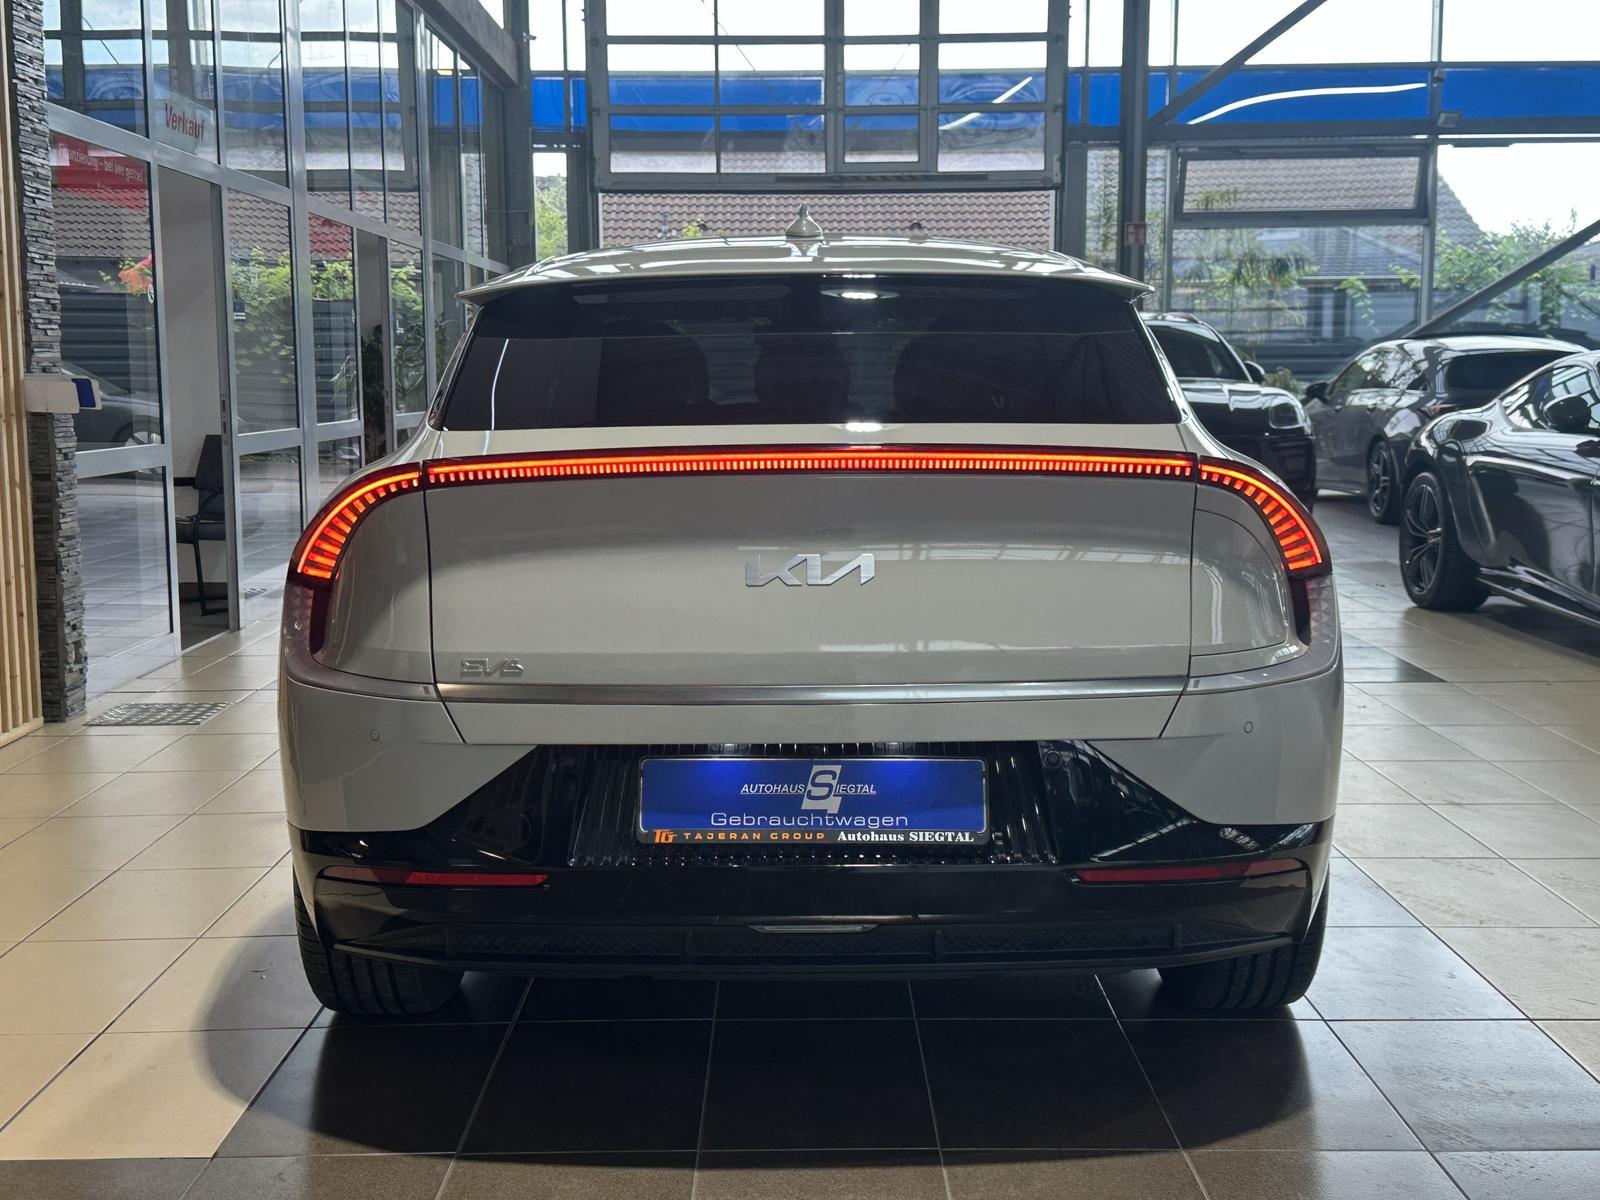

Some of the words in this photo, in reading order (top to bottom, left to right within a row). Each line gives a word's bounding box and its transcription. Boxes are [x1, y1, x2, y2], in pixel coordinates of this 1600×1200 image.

[165, 103, 205, 142] Verkauf
[745, 553, 876, 587] KIA
[741, 784, 805, 795] AUTOHAUS
[711, 812, 908, 828] Gebrauchtwagen
[683, 832, 761, 840] TAJERAN
[769, 832, 825, 840] GROUP
[837, 831, 905, 842] Autohaus
[909, 831, 974, 842] SIEGTAL
